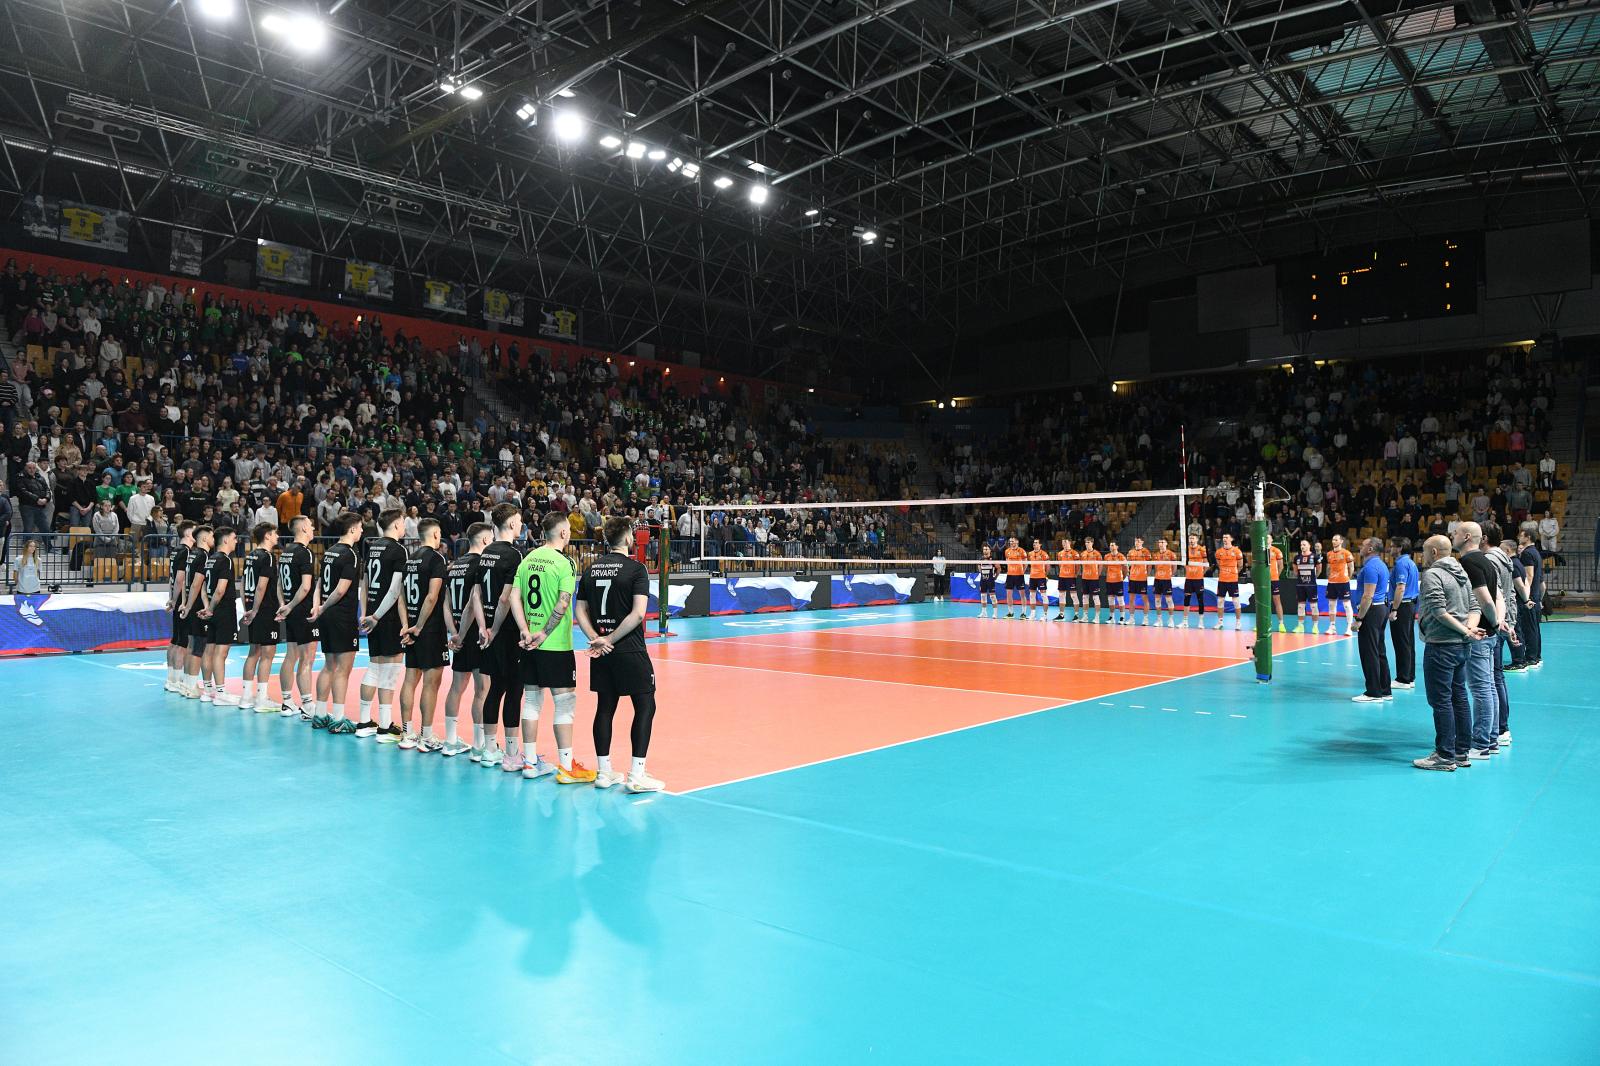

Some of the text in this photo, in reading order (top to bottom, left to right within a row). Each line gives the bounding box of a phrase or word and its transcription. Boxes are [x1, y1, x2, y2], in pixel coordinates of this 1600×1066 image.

[1341, 275, 1348, 285] 0
[205, 570, 211, 594] 2
[244, 566, 255, 592] 10
[279, 563, 292, 591] 18
[323, 564, 331, 593] 9
[367, 558, 381, 588] 12
[483, 568, 491, 603] 1
[404, 573, 420, 605] 15
[450, 578, 465, 610] 17
[527, 574, 542, 609] 8
[595, 579, 612, 616] 7
[271, 631, 278, 639] 10
[312, 628, 320, 637] 18
[353, 638, 357, 647] 9
[442, 651, 449, 661] 15
[650, 673, 655, 685] 7
